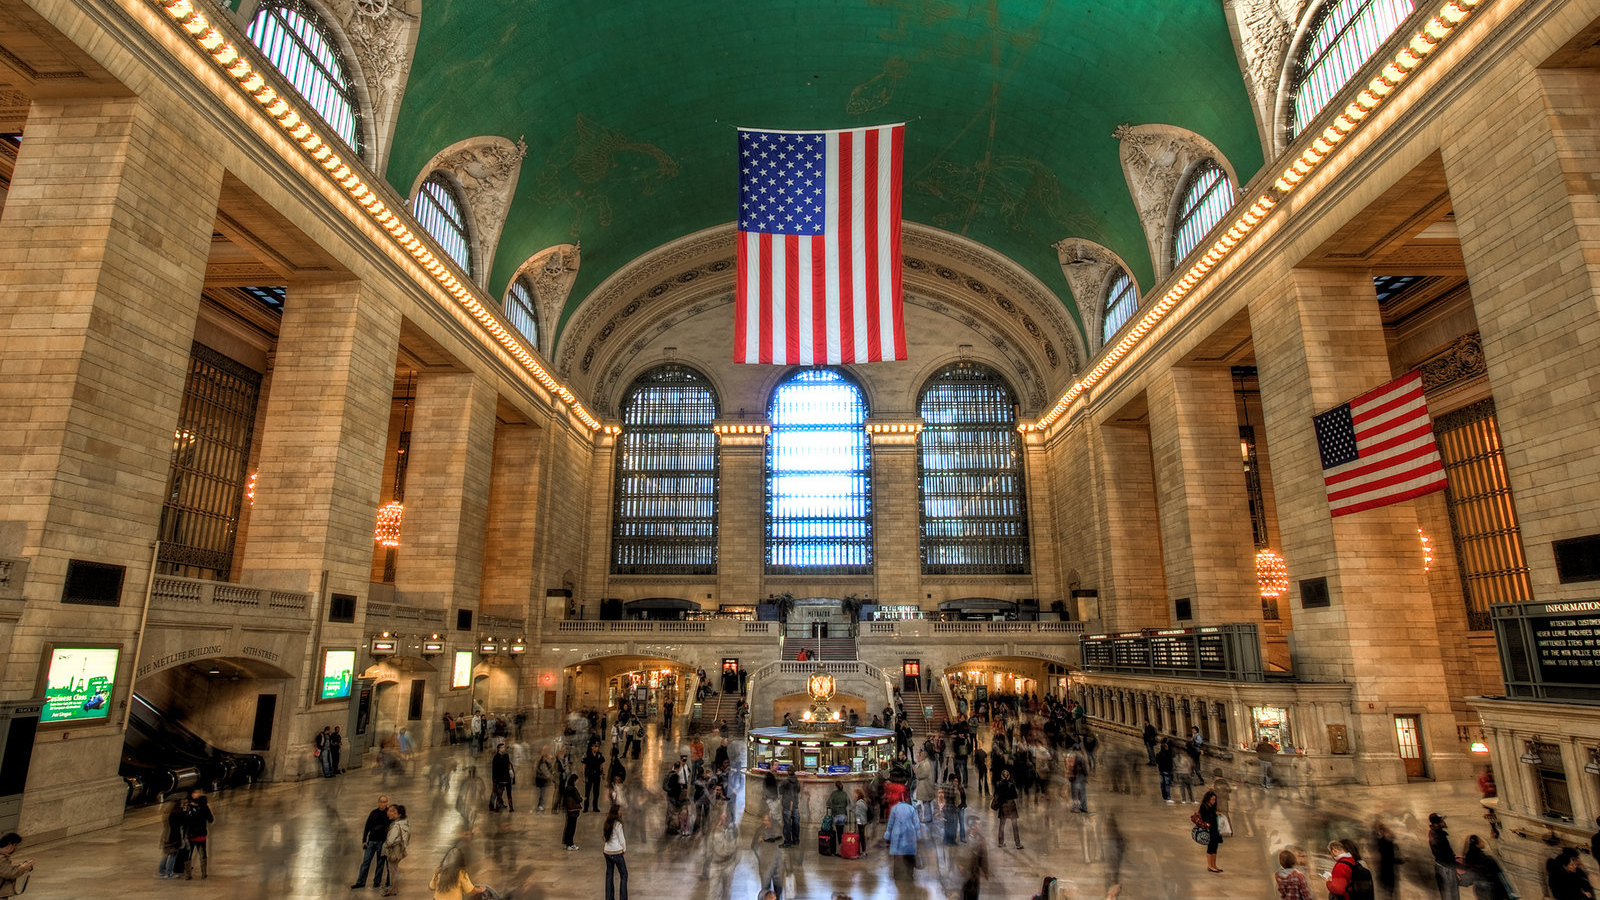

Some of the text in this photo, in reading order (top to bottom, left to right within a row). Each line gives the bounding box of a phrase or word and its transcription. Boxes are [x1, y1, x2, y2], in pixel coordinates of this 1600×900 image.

[1545, 602, 1600, 612] INFORMATION
[153, 650, 186, 670] METLIFE
[187, 645, 221, 658] BUILDING
[242, 646, 279, 661] 45TH STREET
[639, 649, 669, 658] LEXINGTON
[960, 651, 991, 661] LEXINGTON
[73, 693, 87, 701] Class
